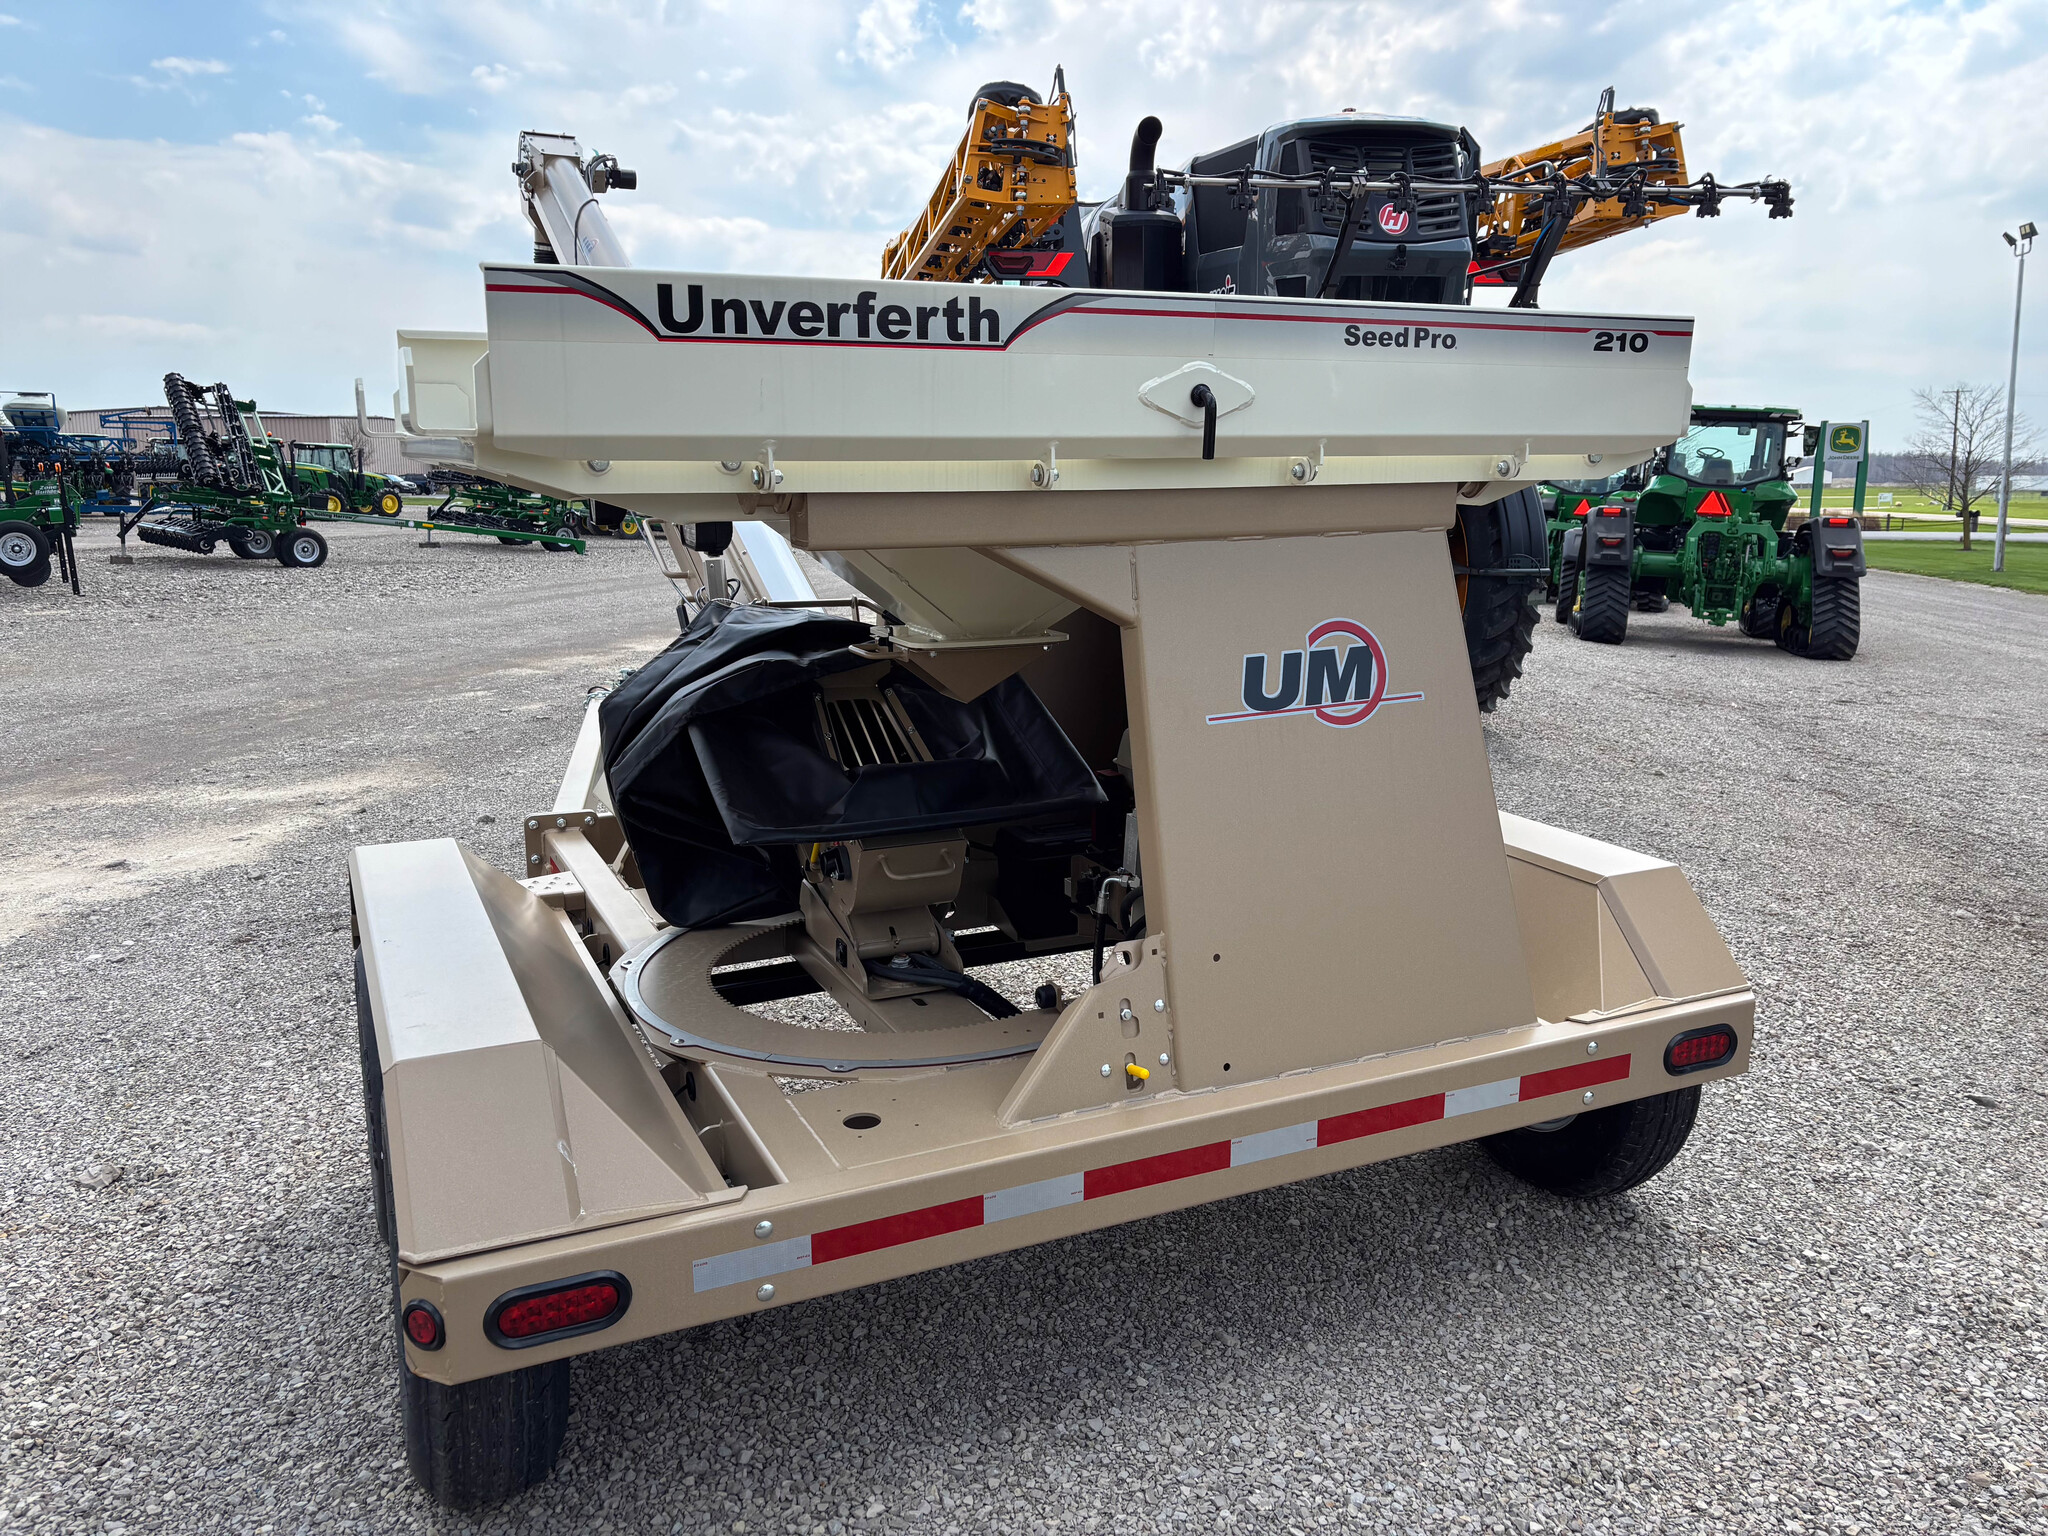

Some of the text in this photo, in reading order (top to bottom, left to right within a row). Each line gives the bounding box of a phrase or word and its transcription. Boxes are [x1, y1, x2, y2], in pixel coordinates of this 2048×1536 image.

[656, 283, 1002, 343] Unverferth
[1593, 331, 1649, 353] 210
[1243, 645, 1374, 712] UM
